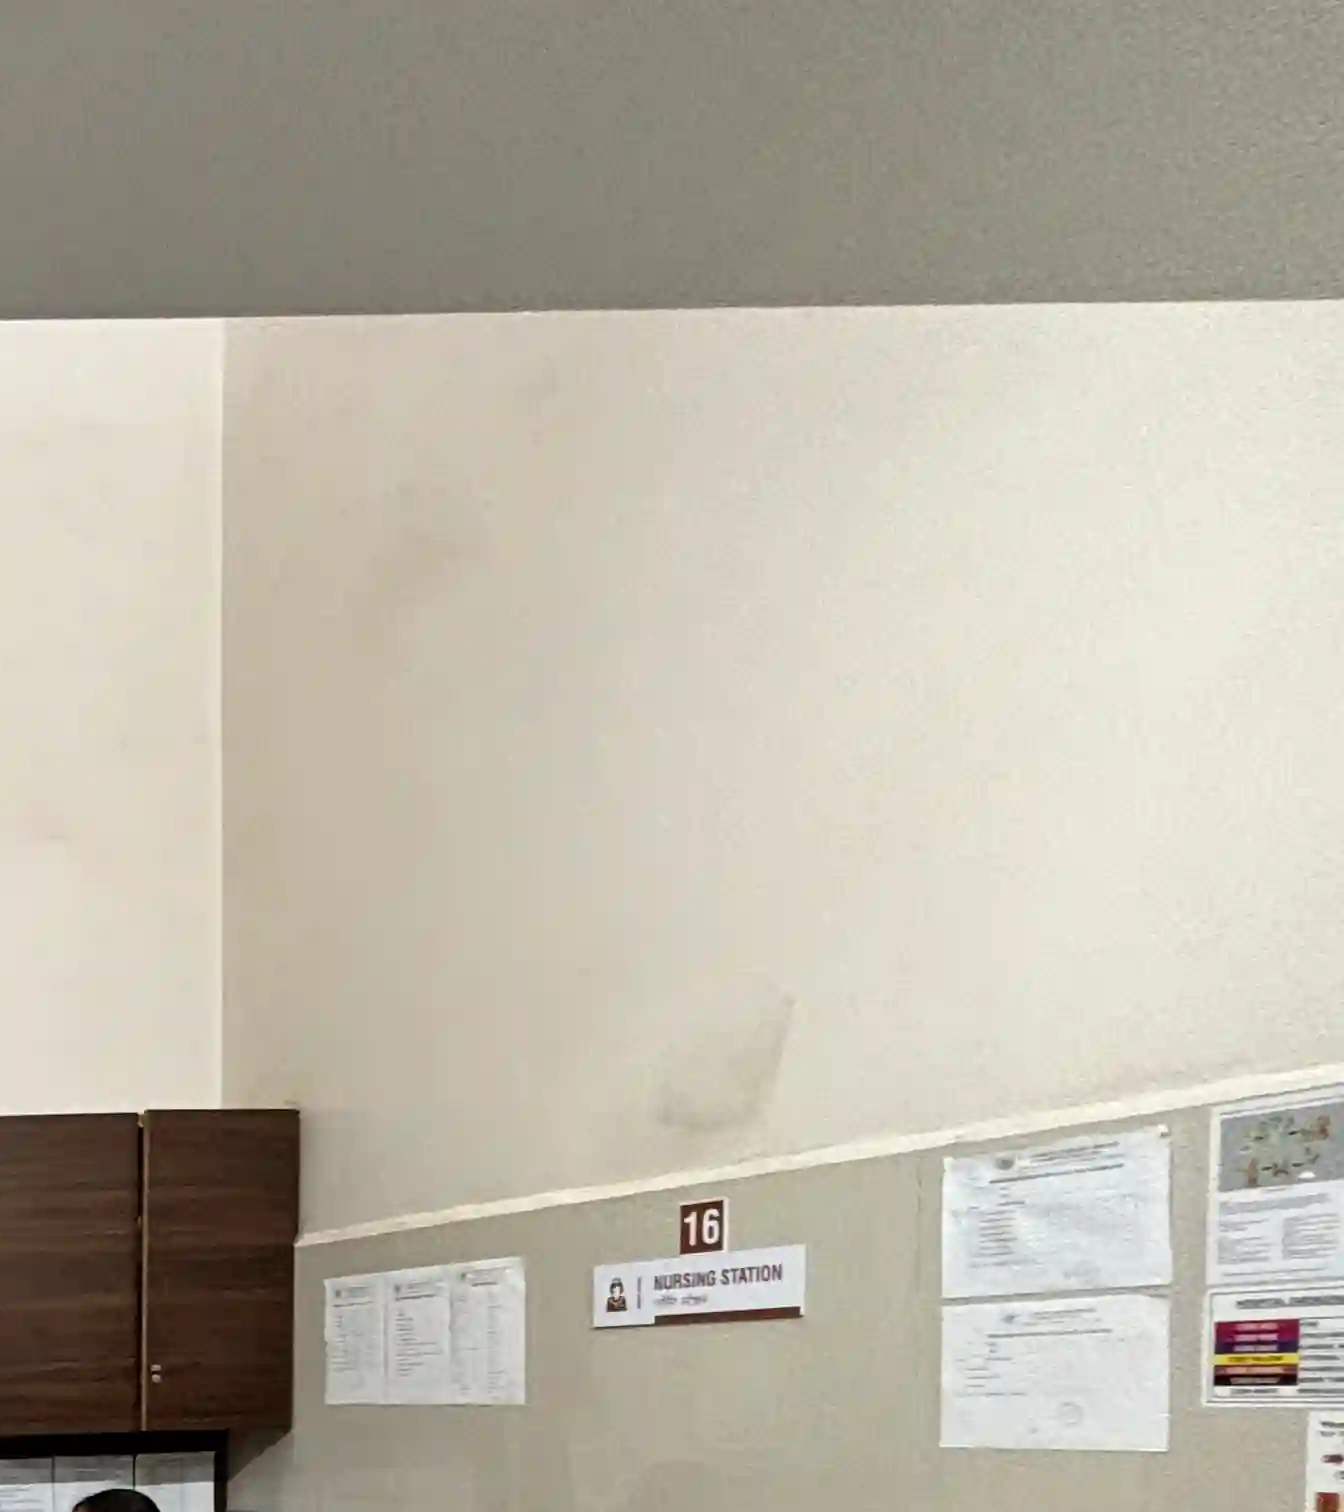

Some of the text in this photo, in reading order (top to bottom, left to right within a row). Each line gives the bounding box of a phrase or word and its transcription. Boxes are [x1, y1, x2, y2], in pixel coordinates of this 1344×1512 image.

[683, 1208, 720, 1246] 16
[654, 1264, 782, 1290] NURSING STATION
